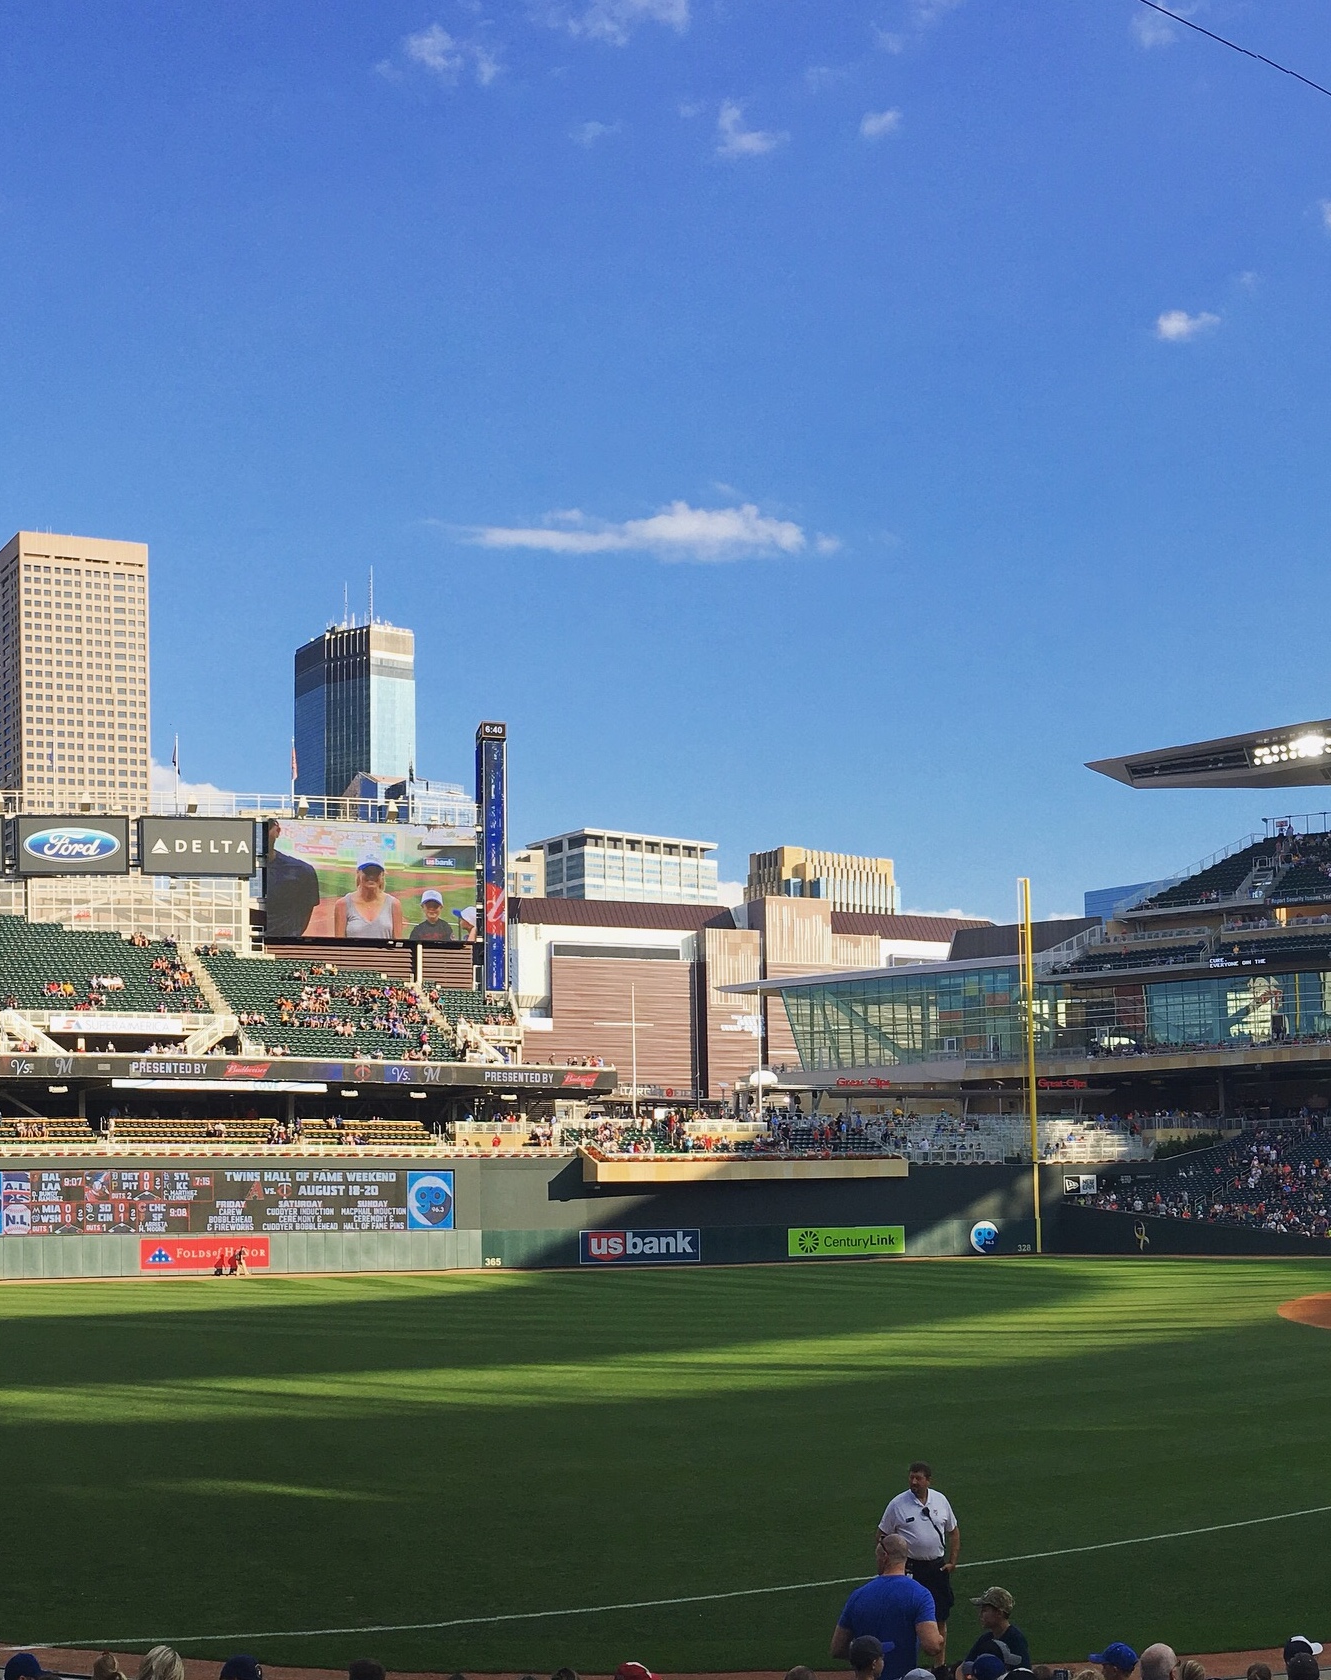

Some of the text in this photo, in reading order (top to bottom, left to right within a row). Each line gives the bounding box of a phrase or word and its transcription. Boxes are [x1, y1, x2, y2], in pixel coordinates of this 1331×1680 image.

[484, 725, 503, 735] 6:40
[44, 832, 101, 856] Ford
[175, 840, 249, 854] DELTA
[425, 858, 454, 867] usbank
[11, 1059, 33, 1075] Vs.
[131, 1061, 207, 1075] PRESENTED BY
[392, 1067, 411, 1082] Vs.
[542, 1072, 554, 1085] BY
[41, 1173, 61, 1181] BAL
[144, 1172, 150, 1180] 0
[225, 1172, 396, 1182] TWINS HALL OF FAME WEEKEND
[64, 1178, 82, 1186] 9:07
[122, 1182, 150, 1190] PIT 0
[194, 1177, 210, 1186] 7:15
[41, 1182, 61, 1191] LAA
[298, 1185, 379, 1196] AUGUST 18-20
[216, 1200, 246, 1208] FRIDAY
[278, 1200, 323, 1208] SATURDAY
[357, 1200, 388, 1208] SUNDAY
[415, 1186, 444, 1214] go
[42, 1204, 71, 1213] MIA 0
[100, 1204, 124, 1213] SD 0
[170, 1208, 187, 1217] 9:08
[5, 1213, 30, 1227] N.L.
[40, 1214, 71, 1223] WSH 0
[97, 1214, 112, 1222] CIN
[152, 1213, 163, 1221] SF
[214, 1223, 254, 1231] FIREWORKS
[824, 1232, 896, 1249] CenturyLink
[974, 1228, 995, 1246] go
[589, 1230, 697, 1256] usbank
[1018, 1244, 1031, 1252] 328
[176, 1248, 211, 1258] FOLDS
[485, 1258, 501, 1266] 365
